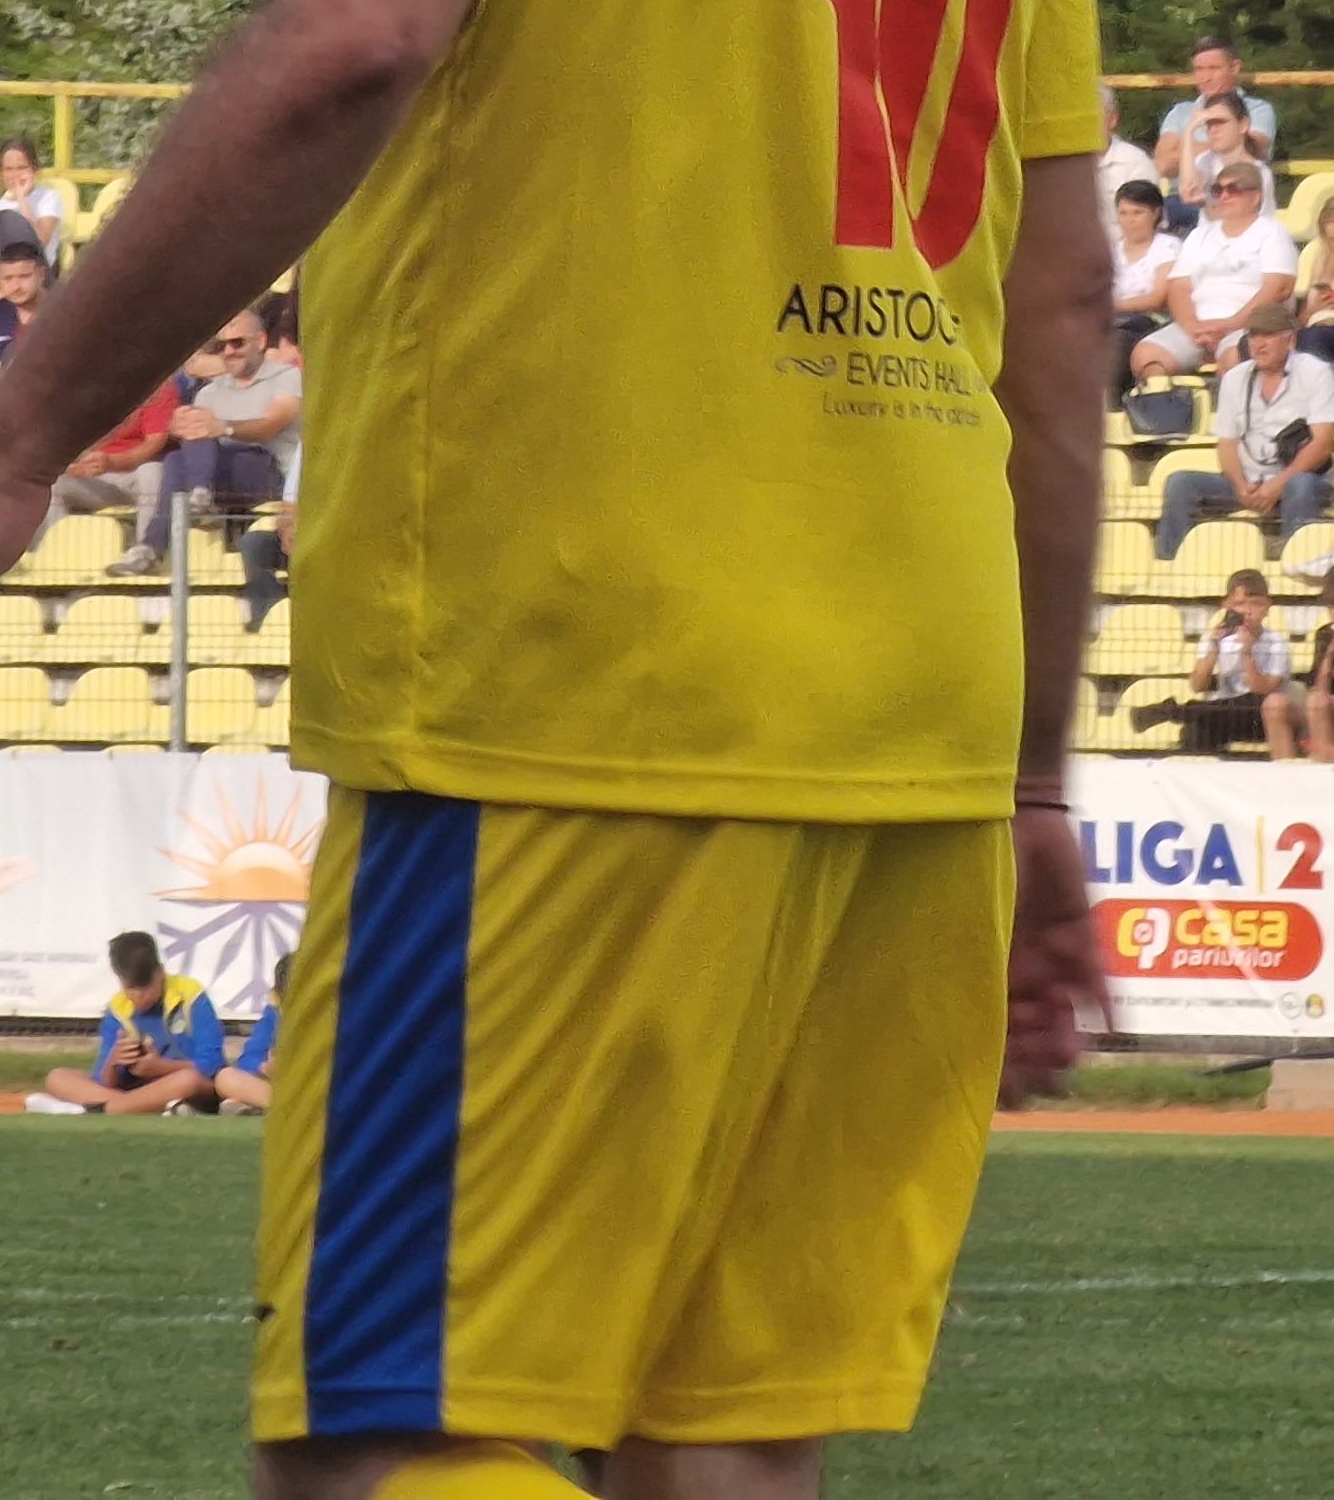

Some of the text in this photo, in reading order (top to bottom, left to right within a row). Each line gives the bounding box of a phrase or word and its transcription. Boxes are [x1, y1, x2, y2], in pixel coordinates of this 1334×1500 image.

[776, 283, 960, 346] ARISTOC
[846, 351, 930, 391] EVENTS
[1079, 819, 1325, 891] LIGA 2
[1175, 907, 1290, 948] casa
